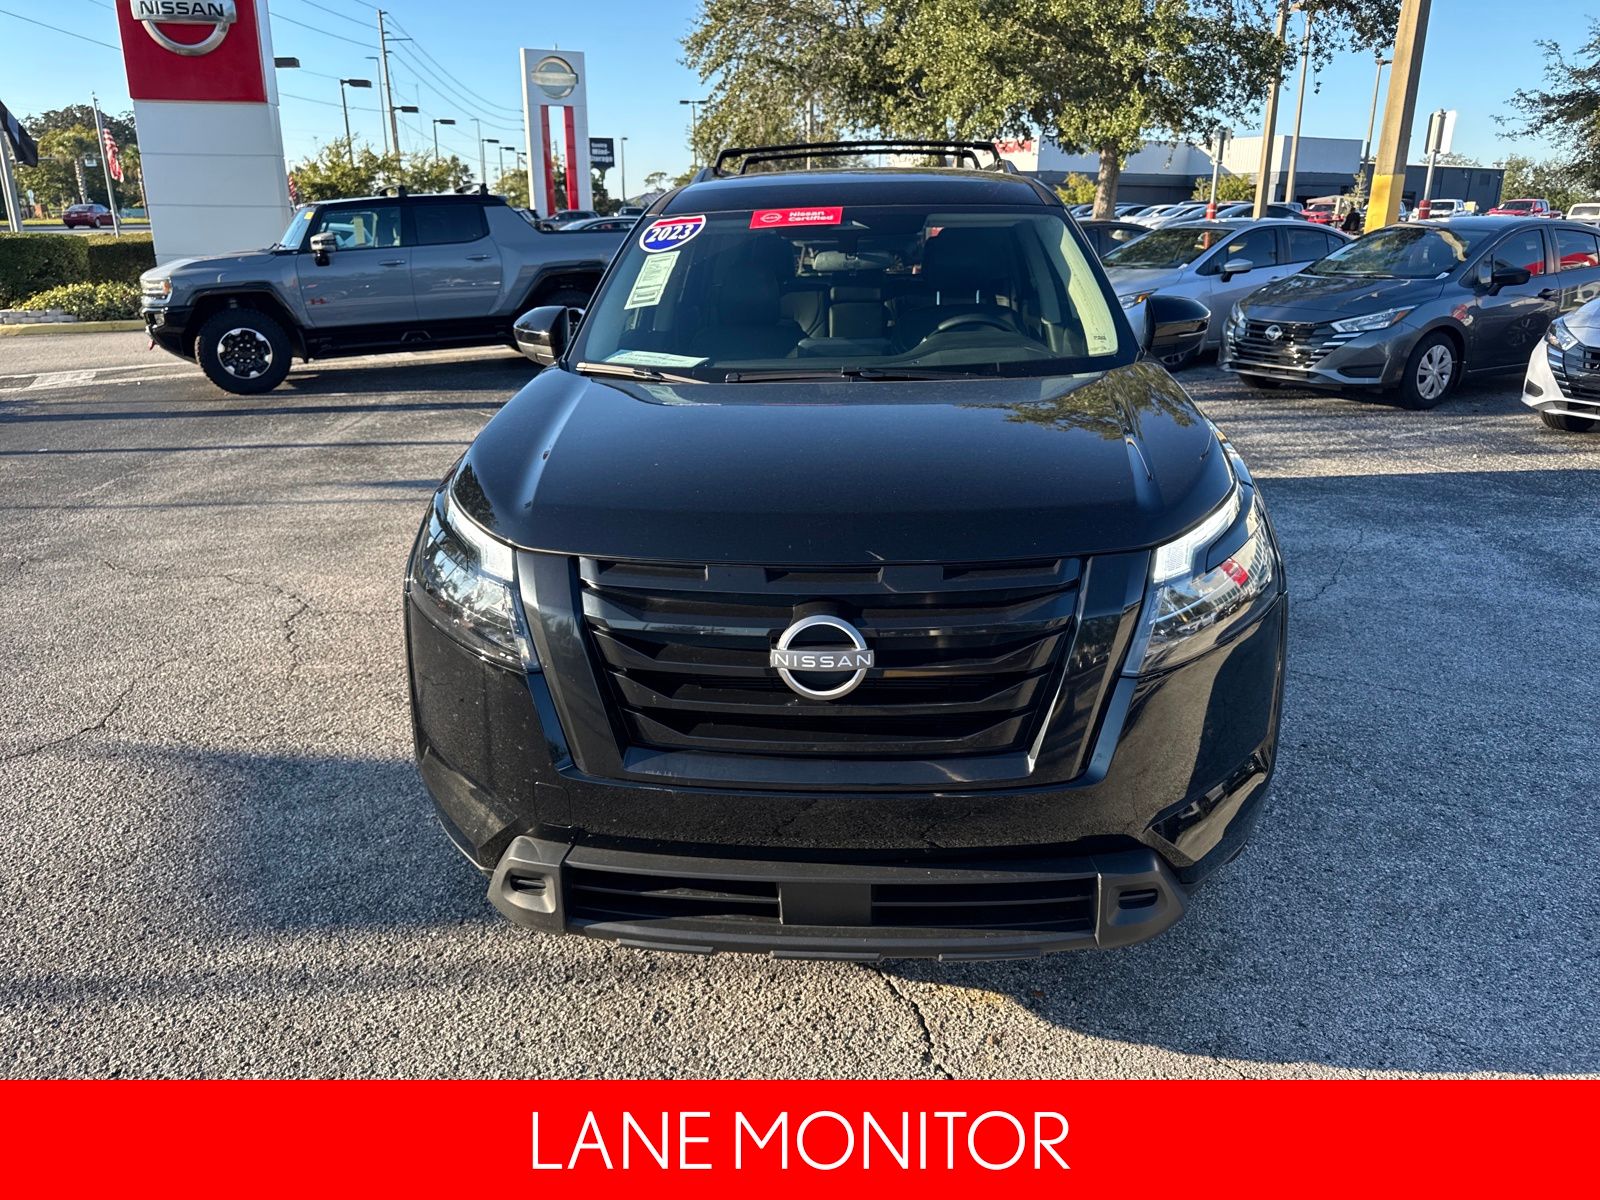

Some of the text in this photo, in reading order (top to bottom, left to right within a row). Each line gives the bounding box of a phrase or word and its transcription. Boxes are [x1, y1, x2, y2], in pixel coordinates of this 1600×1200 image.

[140, 1, 225, 17] NISSAN
[645, 224, 694, 243] 2023
[775, 654, 871, 668] NISSAN
